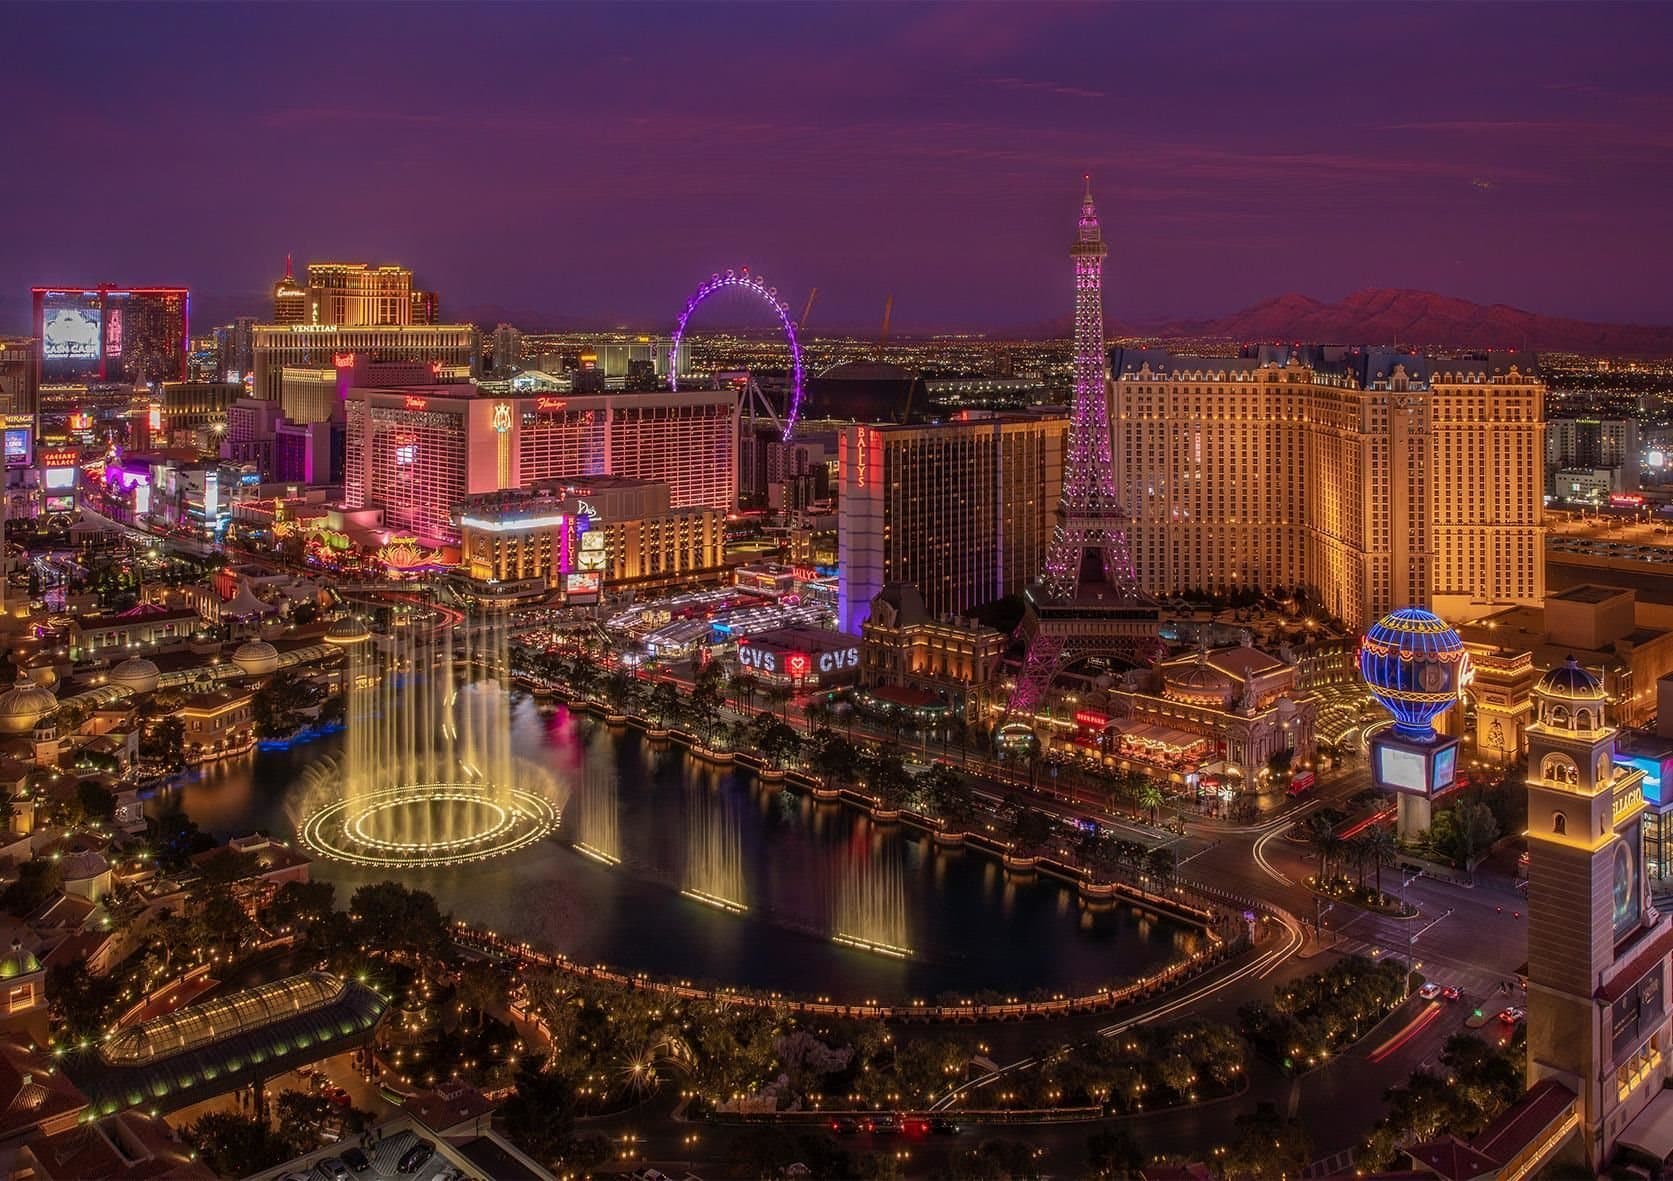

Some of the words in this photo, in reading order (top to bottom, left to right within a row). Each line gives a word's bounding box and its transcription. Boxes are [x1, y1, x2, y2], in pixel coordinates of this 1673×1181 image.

[5, 415, 33, 423] MIRAGE
[857, 427, 866, 488] BALLYS
[567, 518, 575, 565] BALLYS
[739, 646, 775, 671] CVS
[819, 648, 859, 672] CVS
